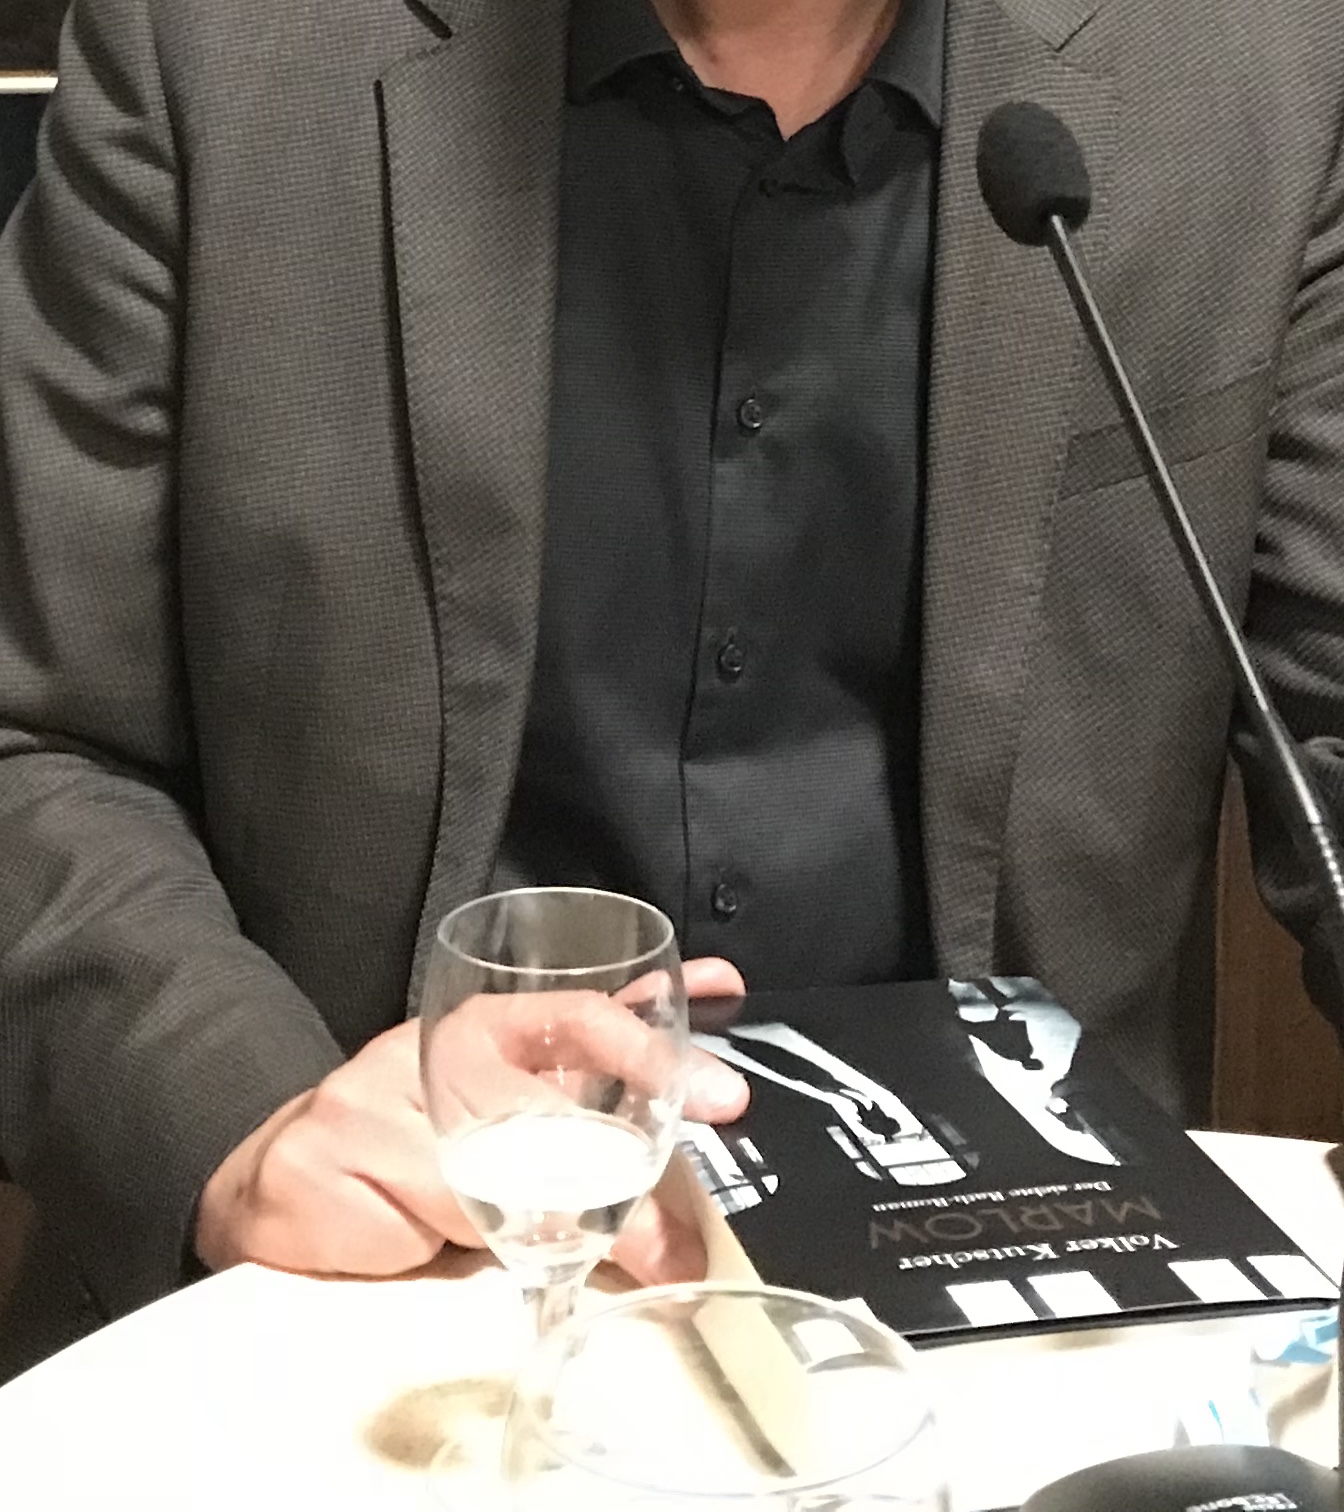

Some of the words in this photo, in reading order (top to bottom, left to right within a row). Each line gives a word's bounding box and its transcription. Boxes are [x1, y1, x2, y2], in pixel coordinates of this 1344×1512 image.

[1074, 1181, 1112, 1191] Der
[872, 1190, 1006, 1212] Rath-Roman
[869, 1196, 1163, 1249] MARLOW
[1066, 1234, 1180, 1253] Volker
[898, 1243, 1060, 1270] Kutscher
